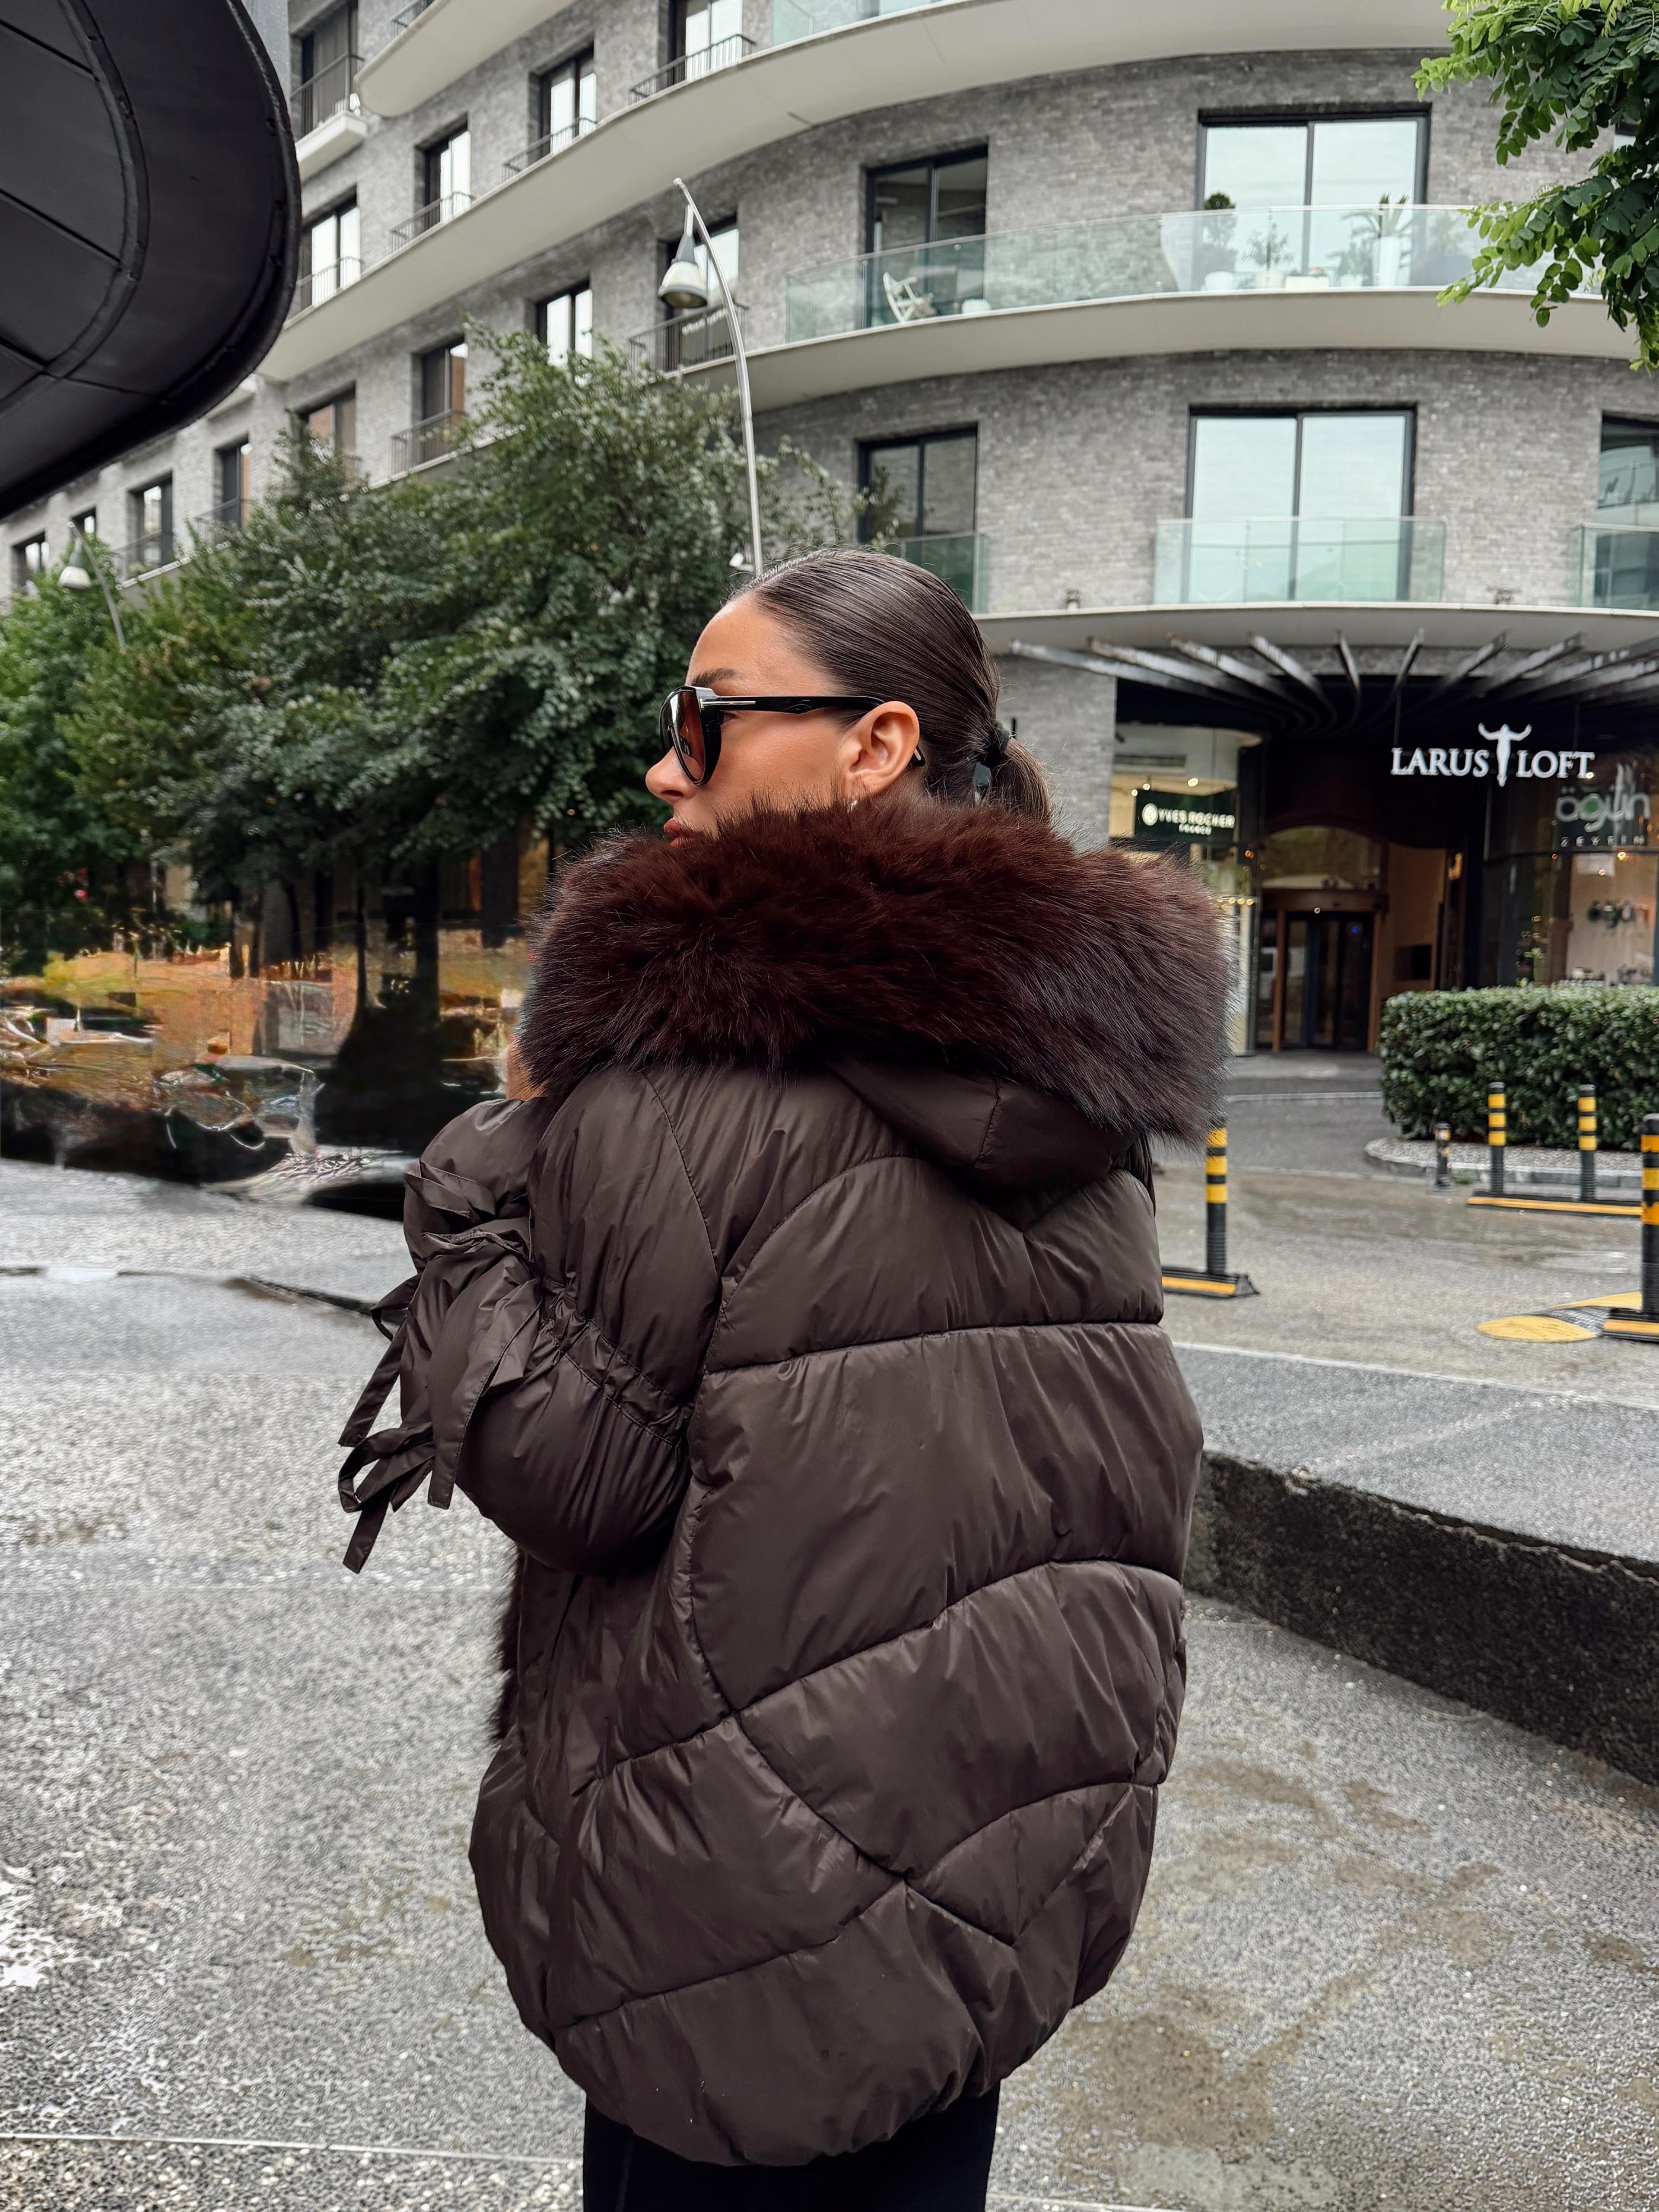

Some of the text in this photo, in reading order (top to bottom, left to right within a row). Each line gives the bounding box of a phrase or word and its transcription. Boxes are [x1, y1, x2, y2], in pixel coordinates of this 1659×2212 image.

[1391, 747, 1595, 778] LARUS LOFT
[1158, 808, 1235, 829] YVES ROCHER
